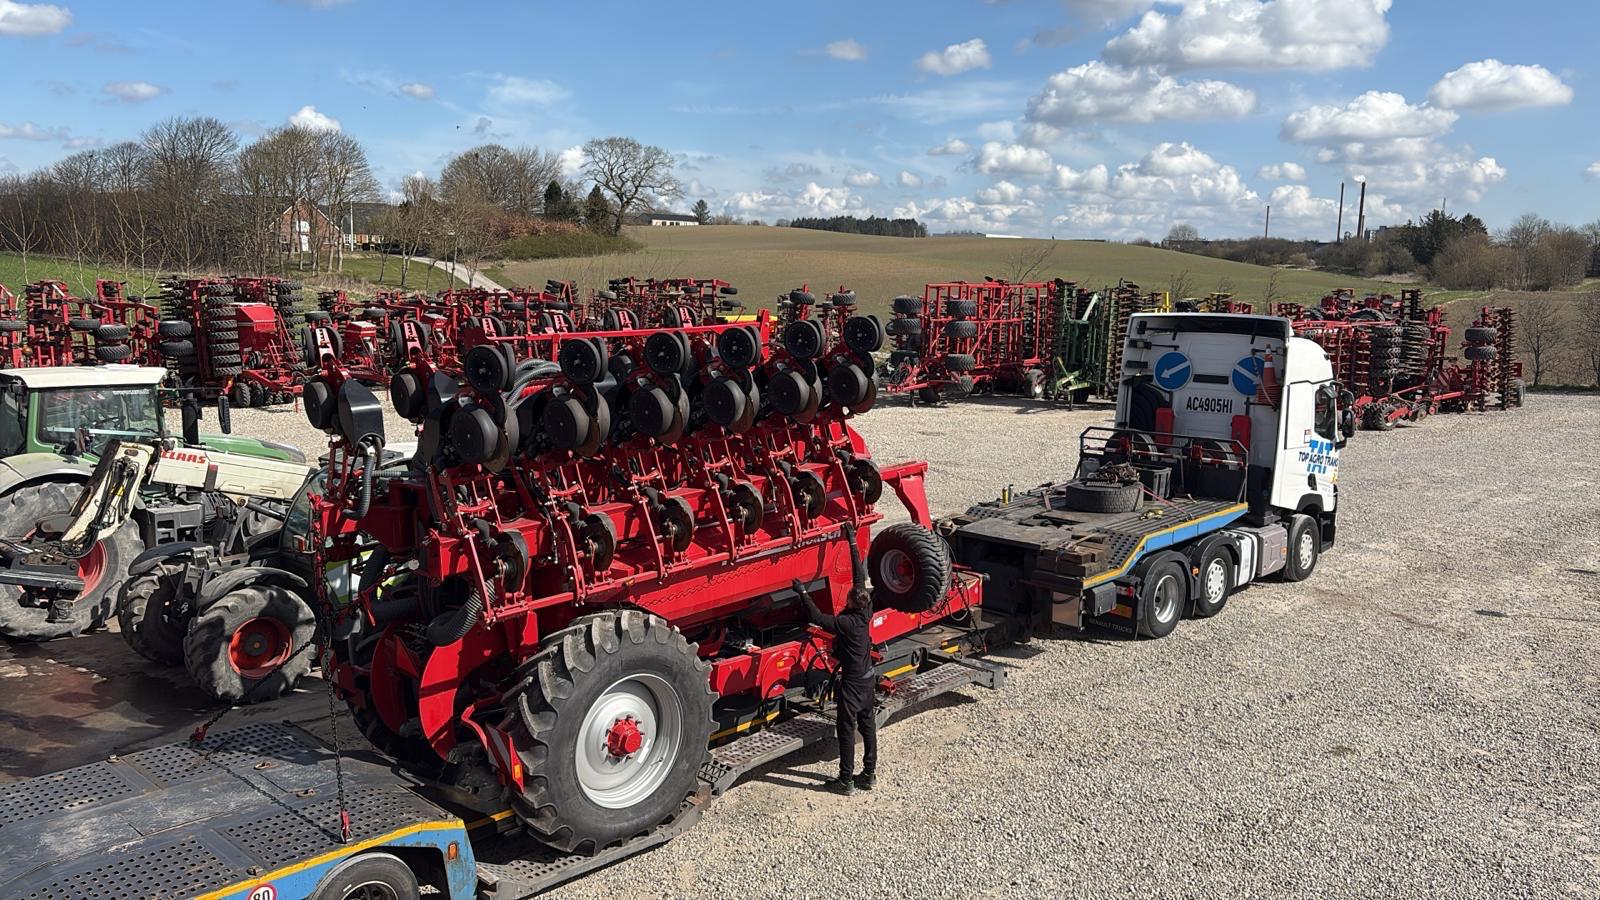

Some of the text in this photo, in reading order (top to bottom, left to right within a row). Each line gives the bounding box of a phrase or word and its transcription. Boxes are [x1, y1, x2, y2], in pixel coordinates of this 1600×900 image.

[1186, 396, 1233, 414] AC4905HI
[161, 451, 206, 464] CLAAS
[1298, 452, 1310, 462] TOP
[1309, 454, 1324, 464] AGRO
